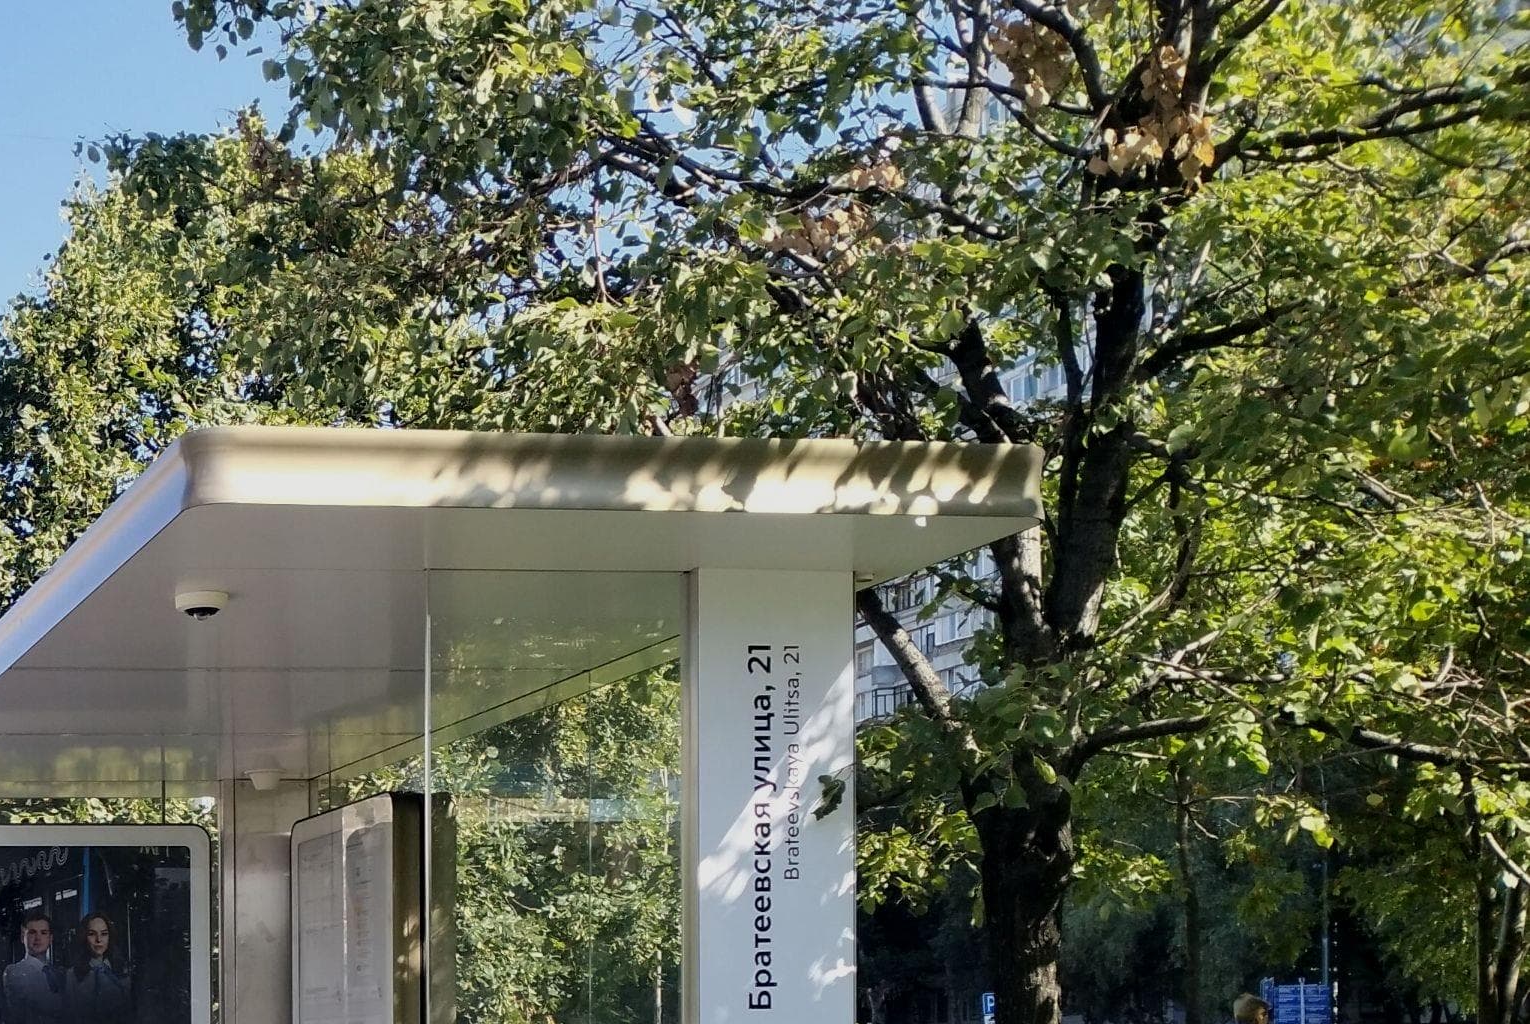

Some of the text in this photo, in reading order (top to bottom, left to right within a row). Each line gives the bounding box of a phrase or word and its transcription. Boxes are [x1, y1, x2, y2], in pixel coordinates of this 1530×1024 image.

[748, 645, 777, 1009] Братеевская улица, 21
[783, 645, 802, 880] Brateevskaya Ulitsa, 21
